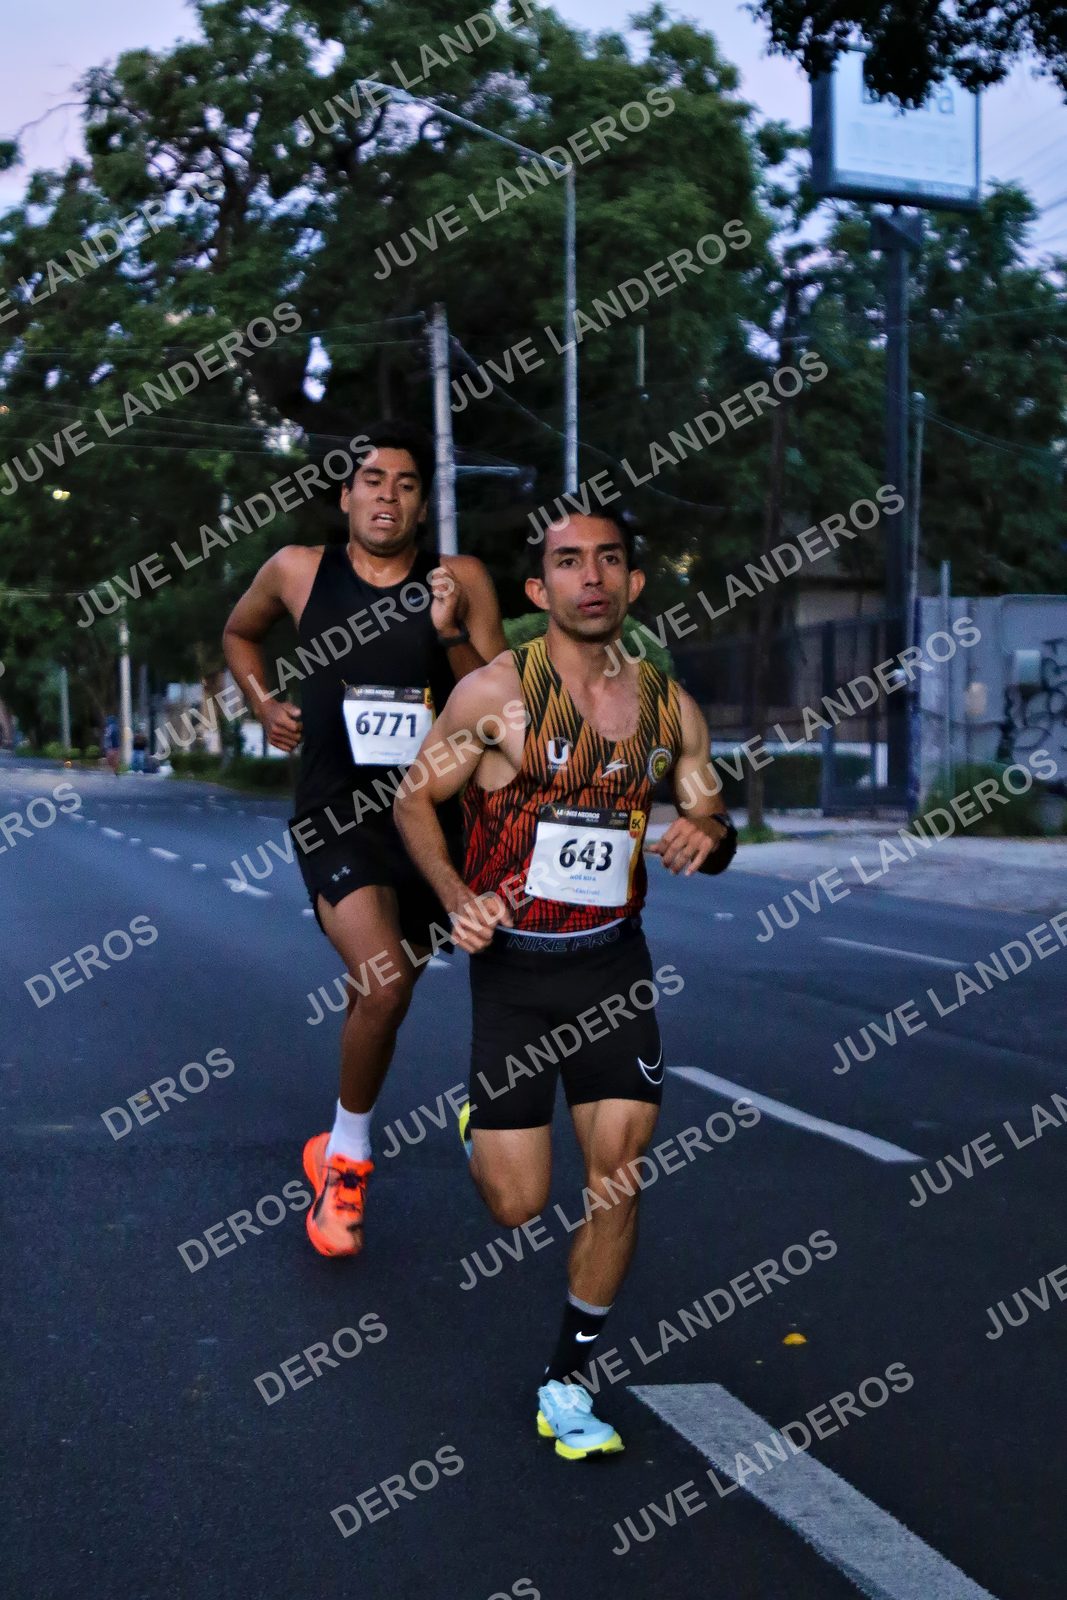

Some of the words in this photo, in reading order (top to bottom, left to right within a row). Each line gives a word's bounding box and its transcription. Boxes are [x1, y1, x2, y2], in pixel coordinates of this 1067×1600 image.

[356, 711, 416, 738] 6771
[559, 838, 613, 872] 643
[506, 934, 570, 952] NIKE
[571, 927, 620, 952] PRO
